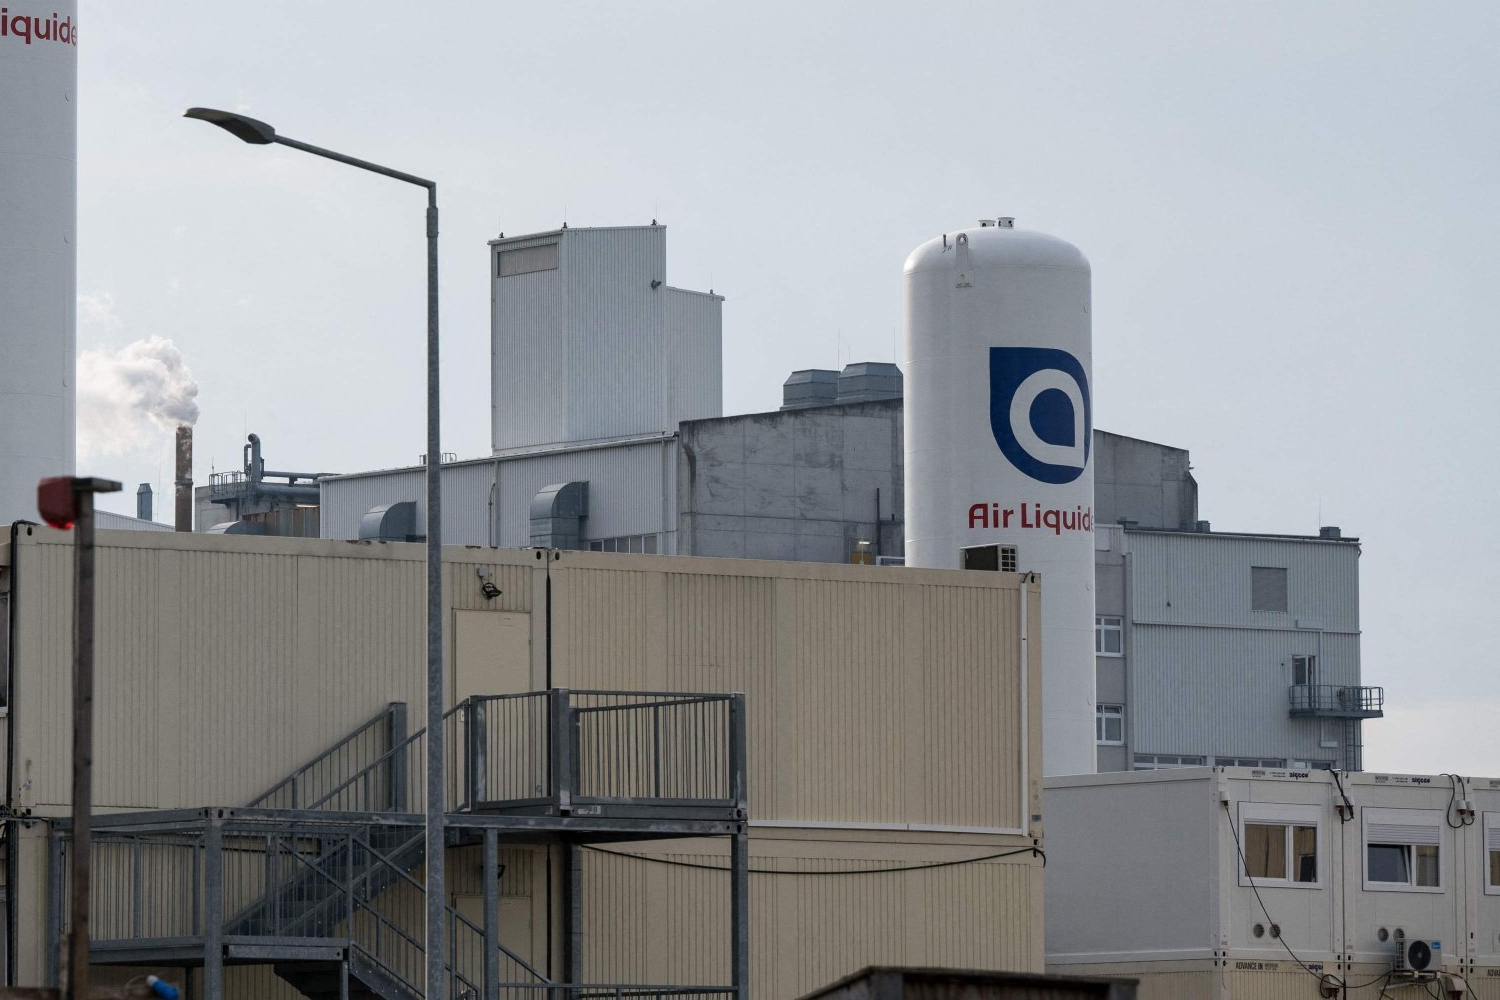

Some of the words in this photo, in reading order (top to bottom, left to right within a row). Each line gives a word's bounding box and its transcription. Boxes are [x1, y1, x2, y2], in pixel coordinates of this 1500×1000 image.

[968, 502, 1014, 529] Air
[1235, 961, 1257, 970] ADVANCE
[1257, 962, 1263, 970] IN
